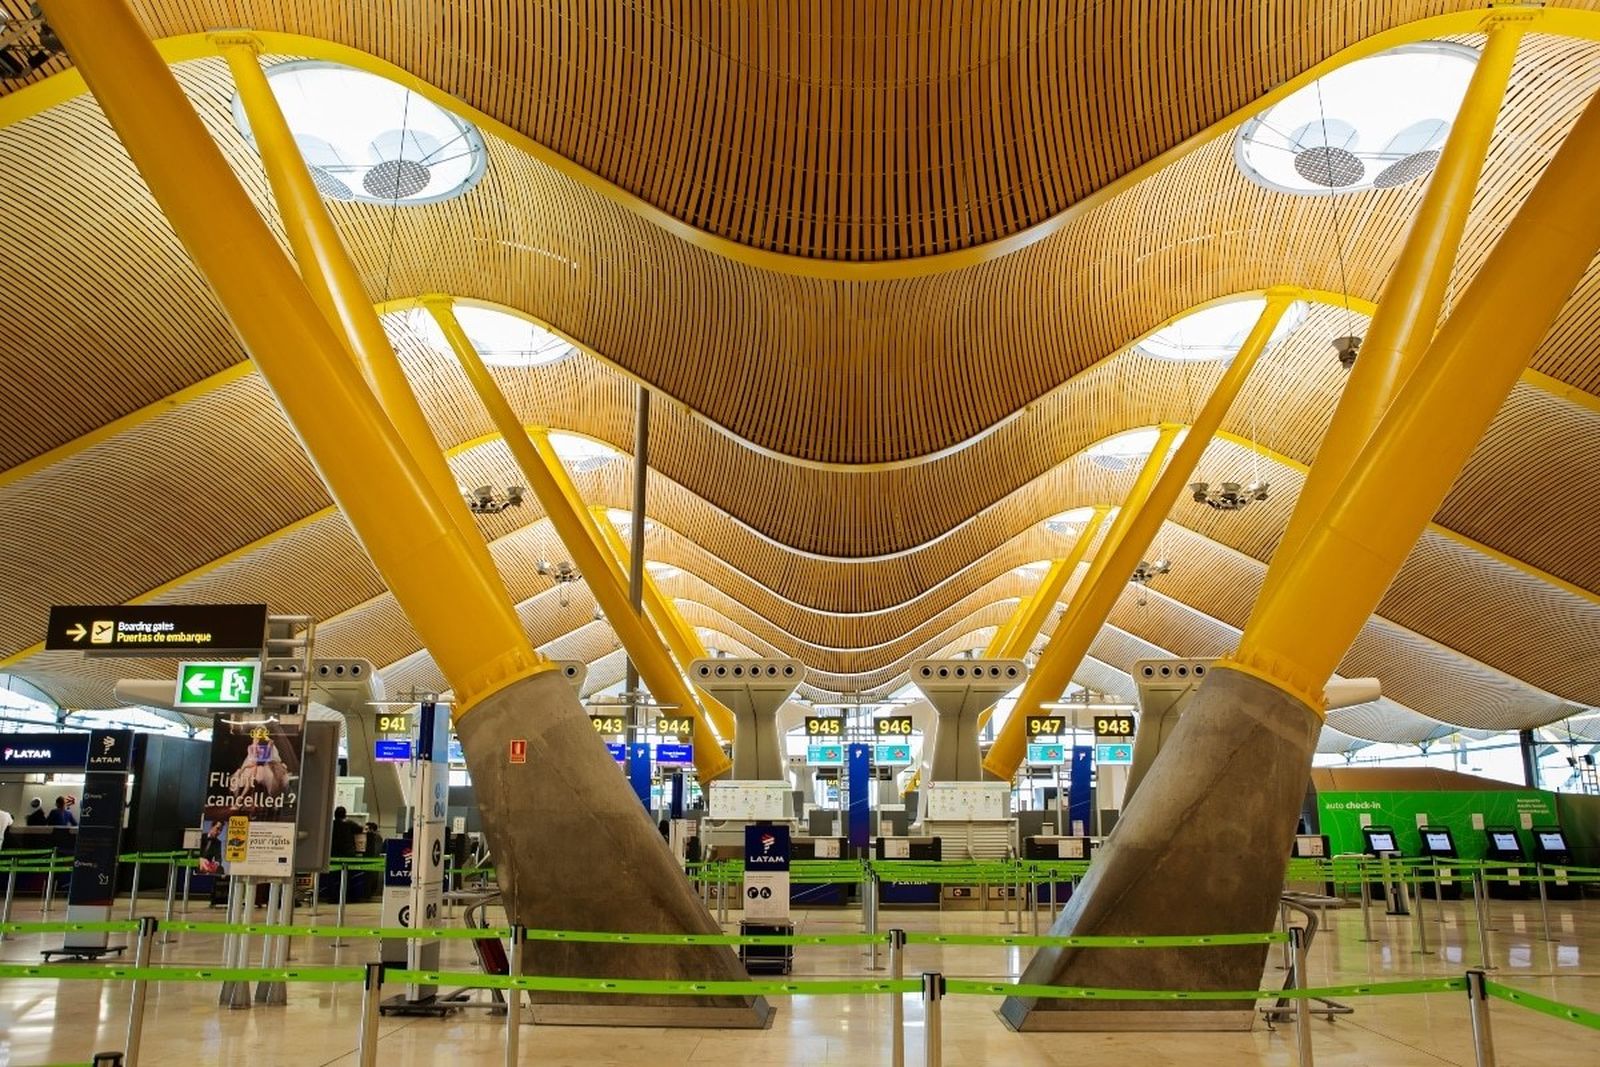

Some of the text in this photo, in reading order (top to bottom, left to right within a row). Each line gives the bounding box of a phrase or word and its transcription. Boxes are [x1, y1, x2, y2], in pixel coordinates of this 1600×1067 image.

[117, 621, 174, 633] Boarding gates
[117, 632, 212, 643] Puertas de embarque
[380, 716, 406, 731] 941
[592, 718, 623, 733] 943
[658, 719, 690, 734] 944
[808, 719, 840, 734] 945
[879, 719, 911, 734] 946
[1031, 720, 1061, 734] 947
[1098, 720, 1130, 734] 948
[14, 749, 51, 759] LATAM
[90, 756, 121, 764] LATAM
[209, 771, 256, 793] Flight
[207, 791, 284, 808] cancelled
[1325, 801, 1381, 810] auto check-in
[750, 855, 785, 863] LATAM
